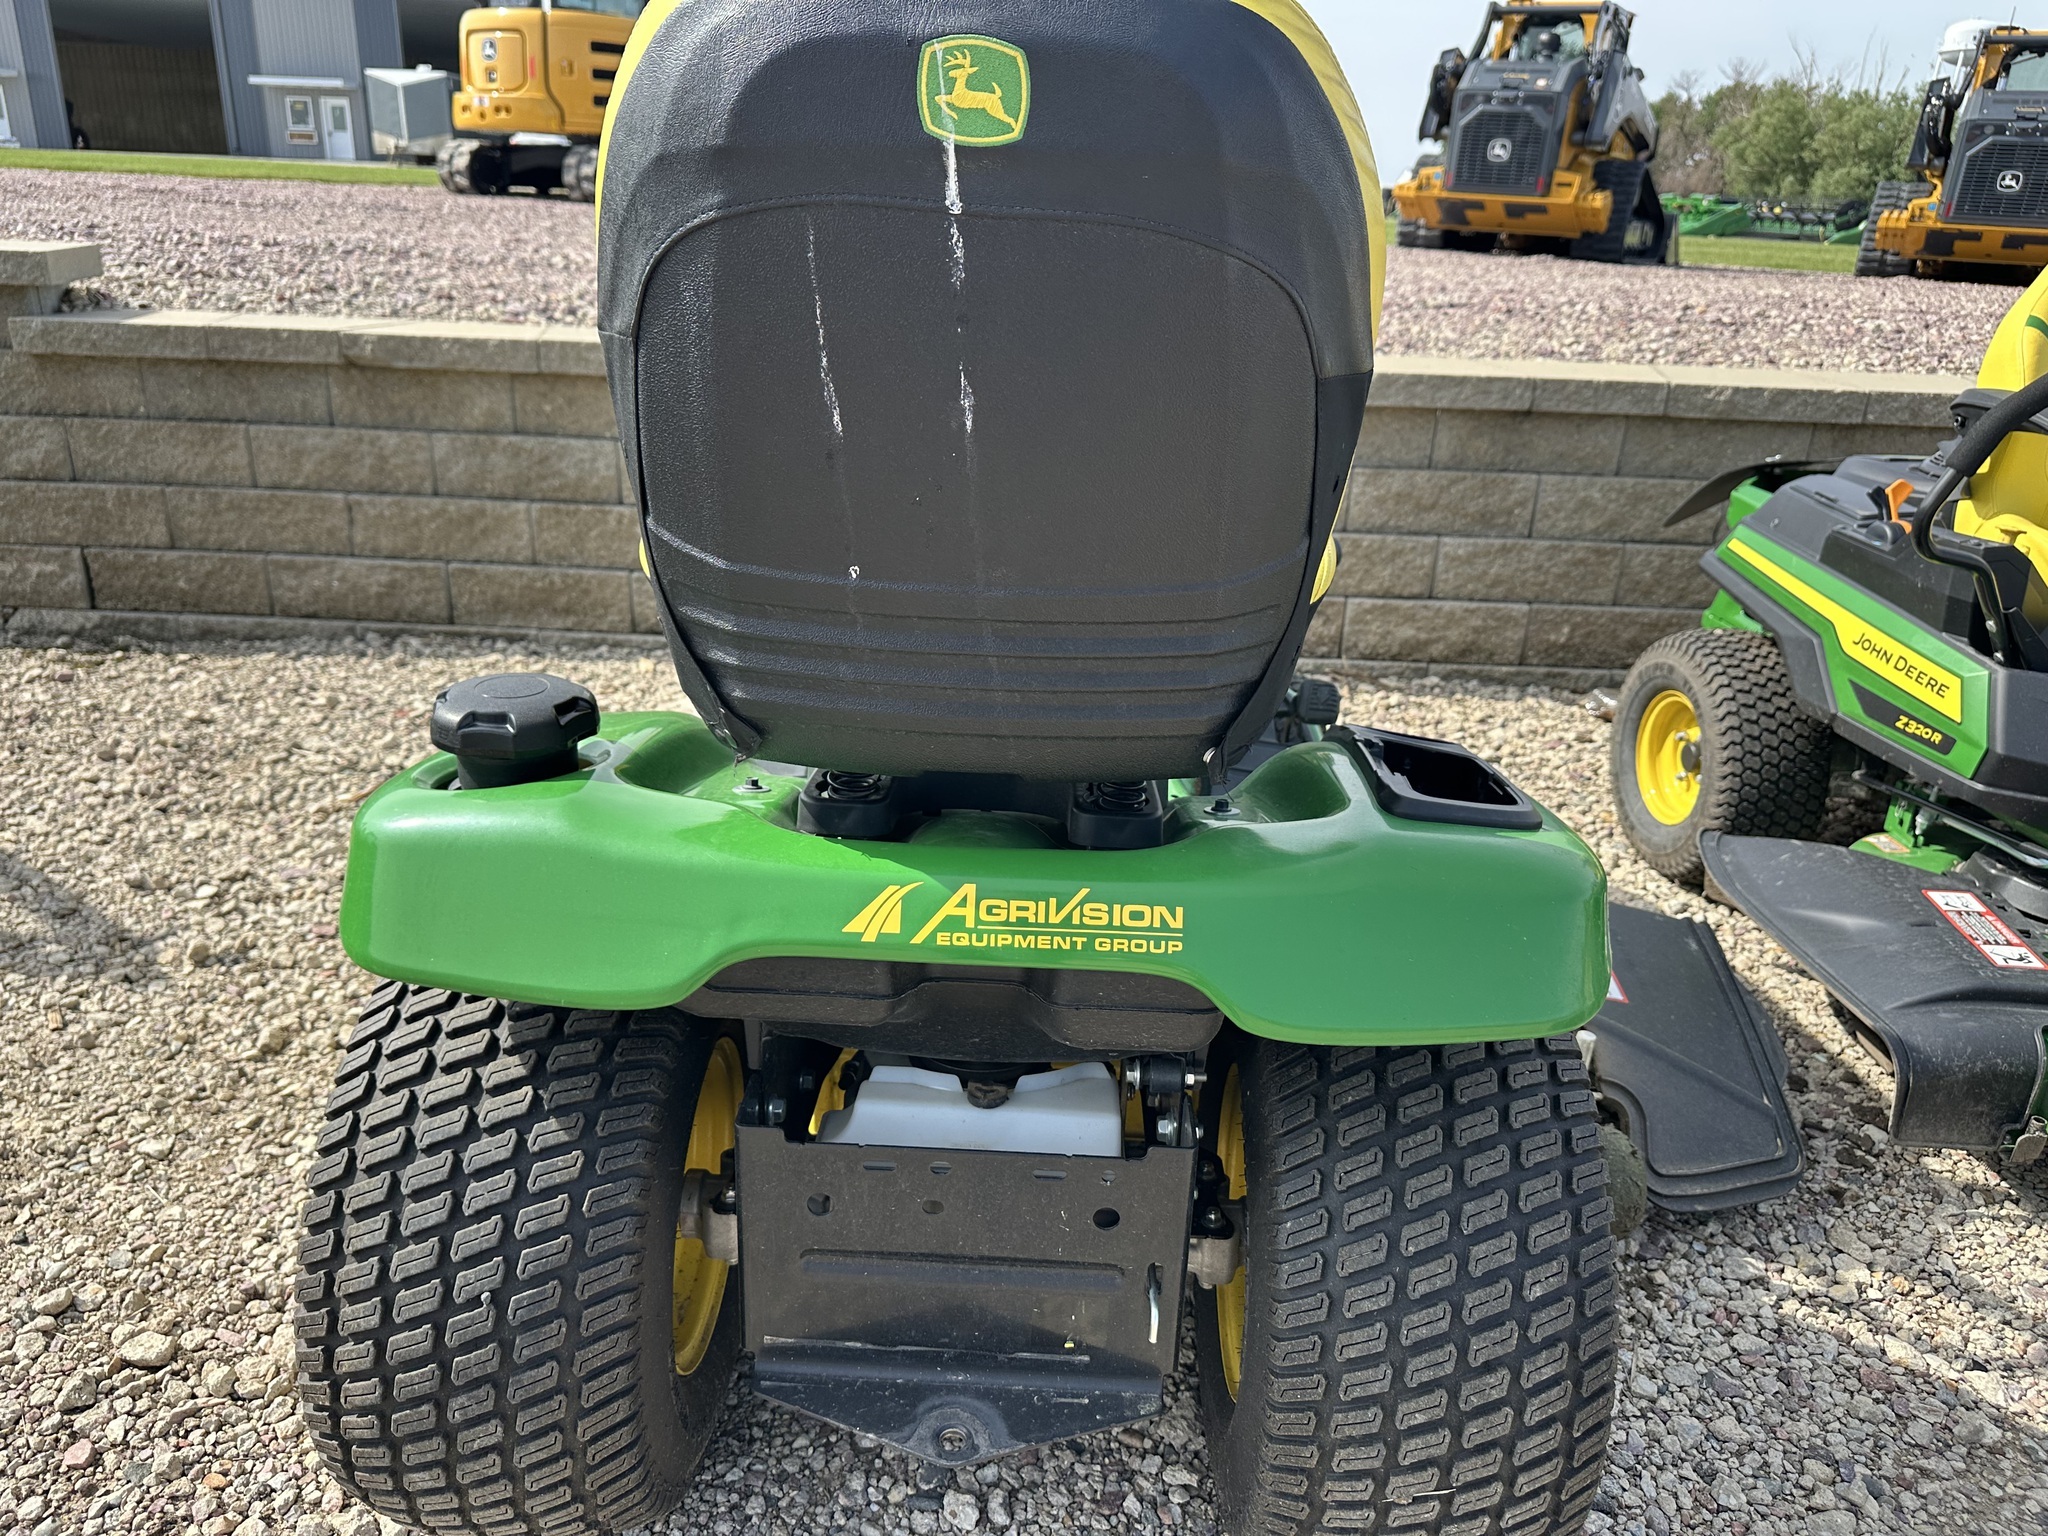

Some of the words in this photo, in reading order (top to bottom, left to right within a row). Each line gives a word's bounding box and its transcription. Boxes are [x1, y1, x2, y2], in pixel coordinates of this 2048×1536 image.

[1852, 632, 1894, 665] JOHN
[1893, 655, 1950, 699] DEERE
[1894, 714, 1943, 745] Z320R
[936, 932, 1088, 950] EQUIPMENT
[1094, 937, 1184, 954] GROUP
